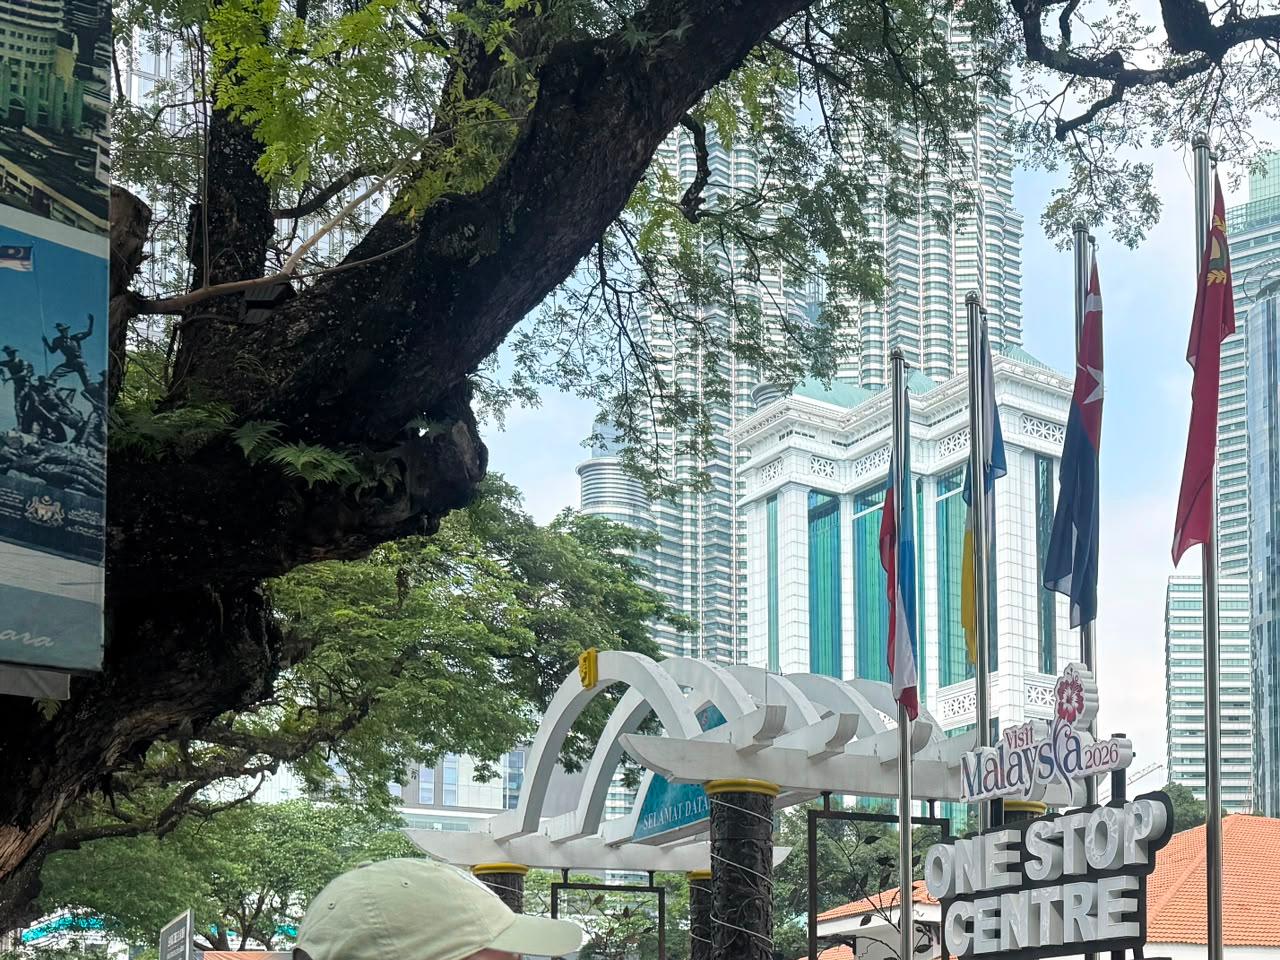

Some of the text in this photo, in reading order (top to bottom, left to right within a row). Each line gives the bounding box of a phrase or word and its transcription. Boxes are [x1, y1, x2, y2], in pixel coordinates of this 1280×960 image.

[1085, 743, 1119, 769] 2026
[642, 795, 711, 831] SELAMAT DATA
[925, 799, 1167, 899] ONE STOP
[945, 875, 1140, 957] CENTRE
